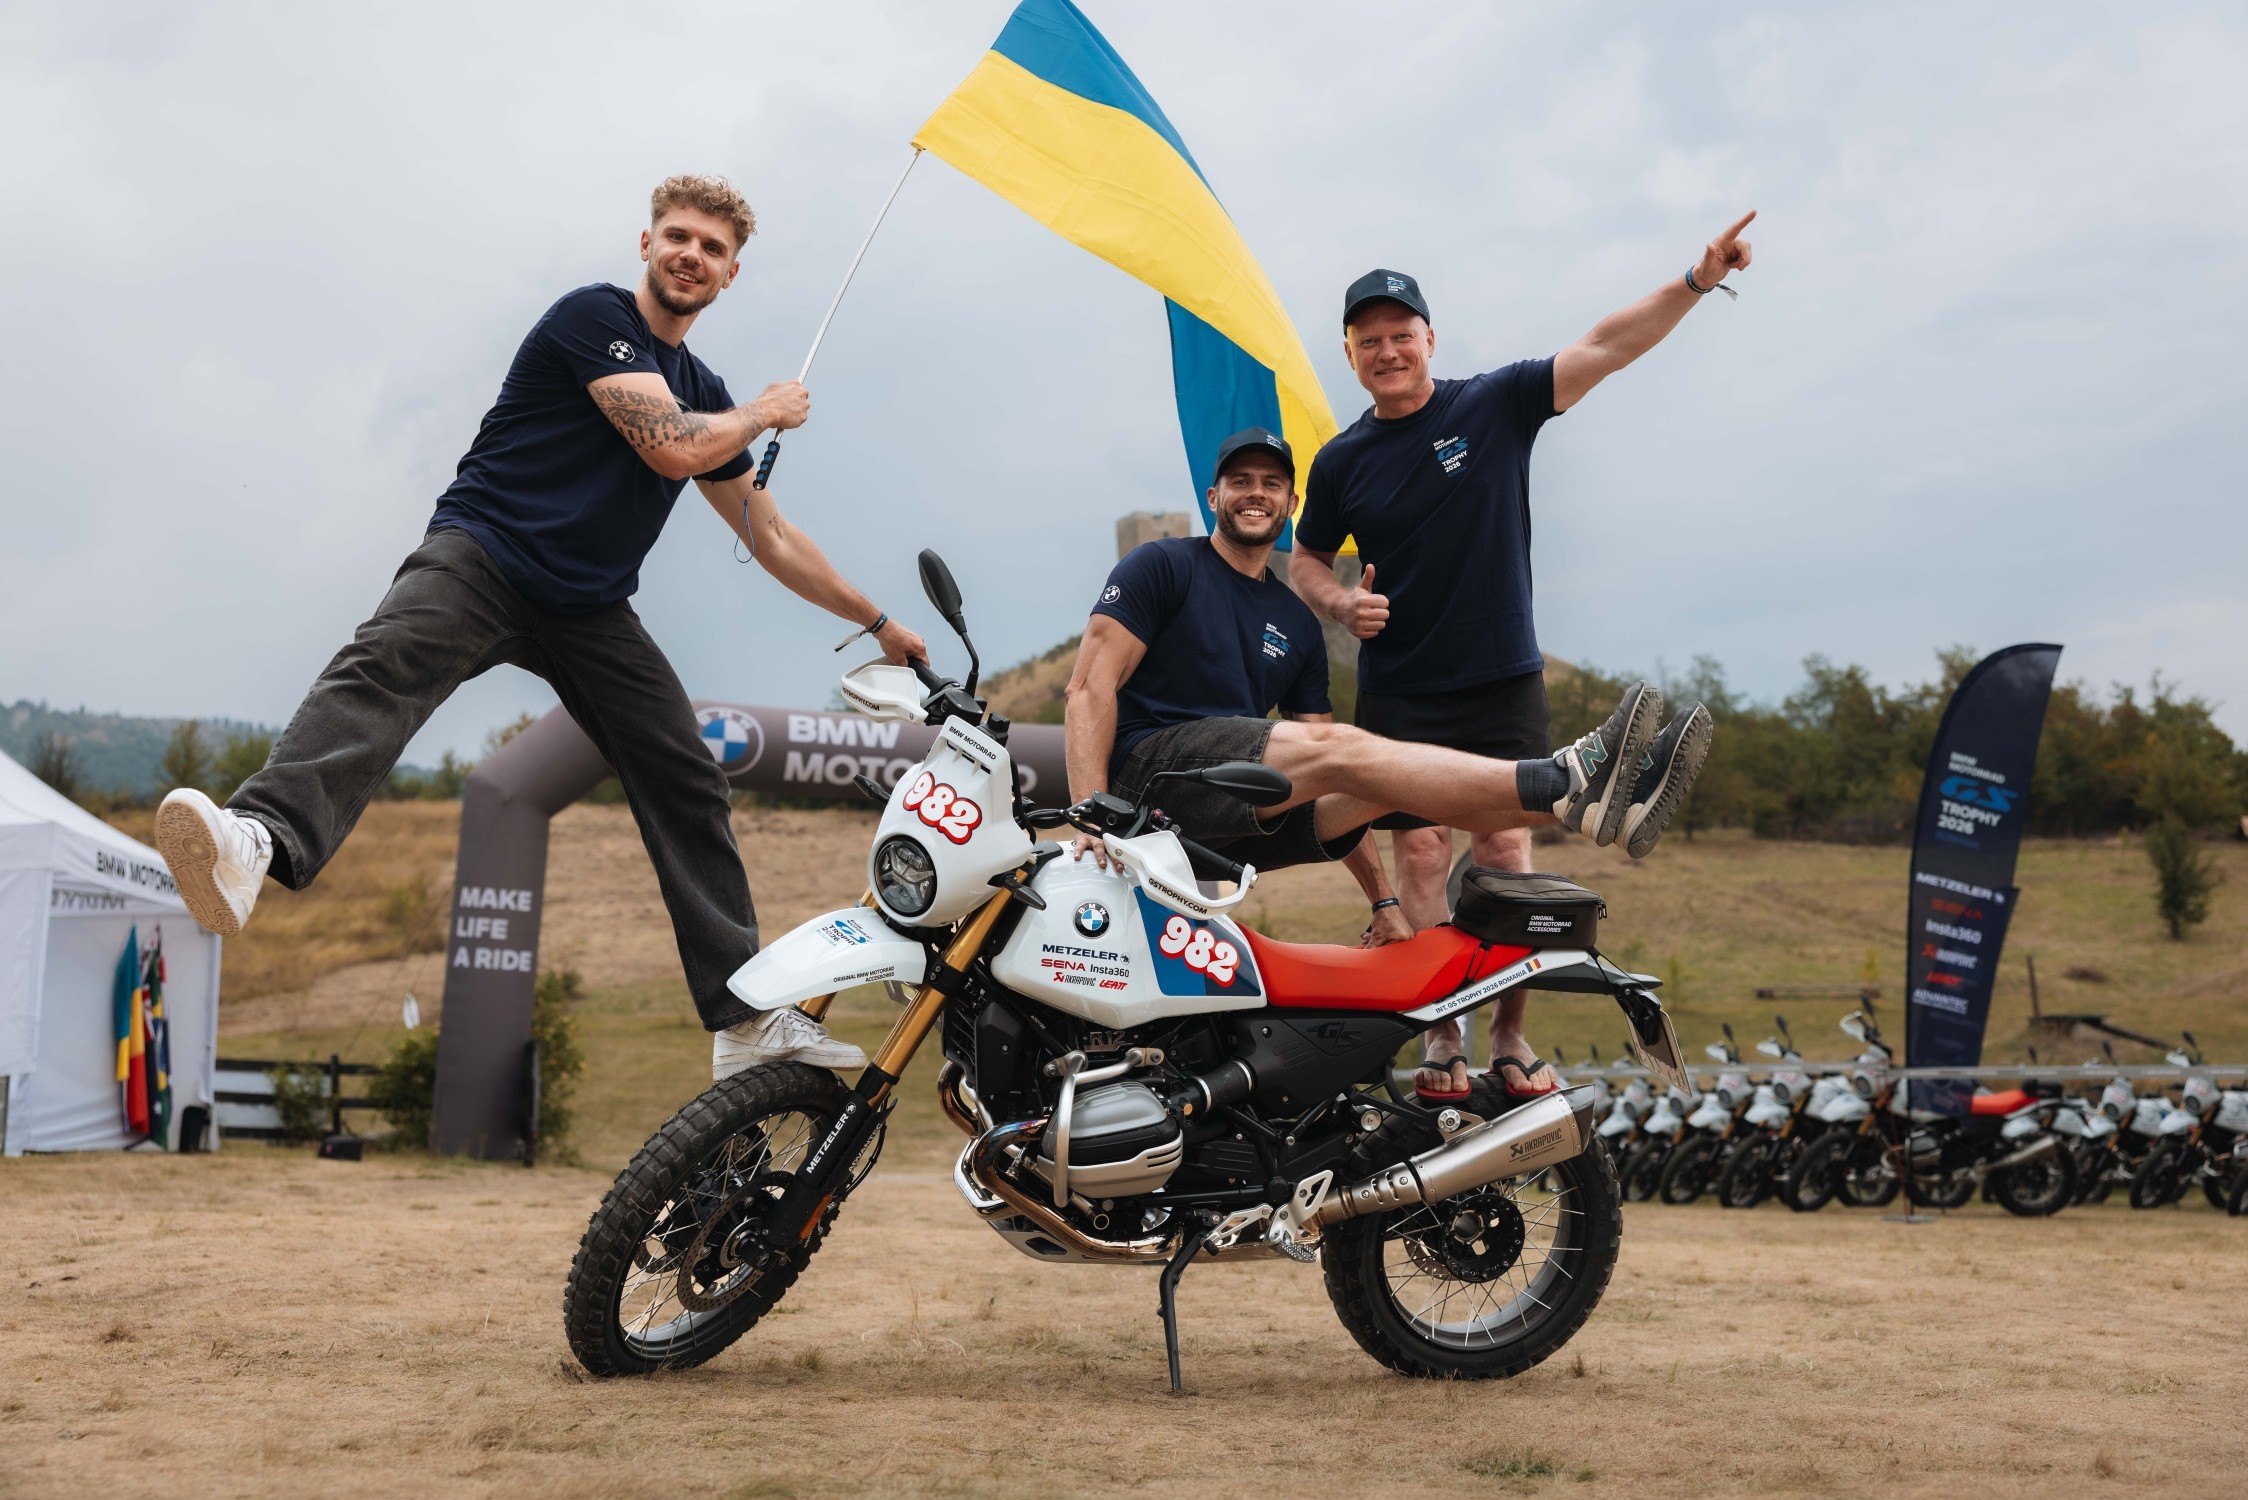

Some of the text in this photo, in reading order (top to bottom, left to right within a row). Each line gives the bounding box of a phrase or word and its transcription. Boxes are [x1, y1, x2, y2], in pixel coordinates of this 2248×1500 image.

[1442, 450, 1467, 467] TROPHY
[1445, 461, 1461, 473] 2026
[1262, 647, 1277, 658] 2026
[1263, 641, 1285, 657] TROPHY
[787, 713, 901, 750] BMW
[948, 726, 997, 760] BMW MOTORRAD
[903, 771, 982, 845] 982
[1939, 775, 2019, 813] GS
[1937, 814, 1975, 835] 2026
[1940, 799, 2001, 828] TROPHY
[96, 850, 126, 879] BMW
[459, 885, 533, 913] MAKE
[1148, 877, 1208, 915] GSTROPHY.COM
[1915, 870, 1994, 901] METZELER
[456, 915, 509, 941] LIFE
[453, 946, 533, 973] A RIDE
[1042, 943, 1119, 962] METZELER
[1158, 914, 1240, 988] 982
[833, 965, 895, 983] ORIGINAL BMW MOTORRAD
[1041, 958, 1130, 978] SENA Insta360
[1435, 969, 1528, 1014] INT. GS TROPHY 2026 ROMANIA
[805, 1112, 850, 1174] METZELER
